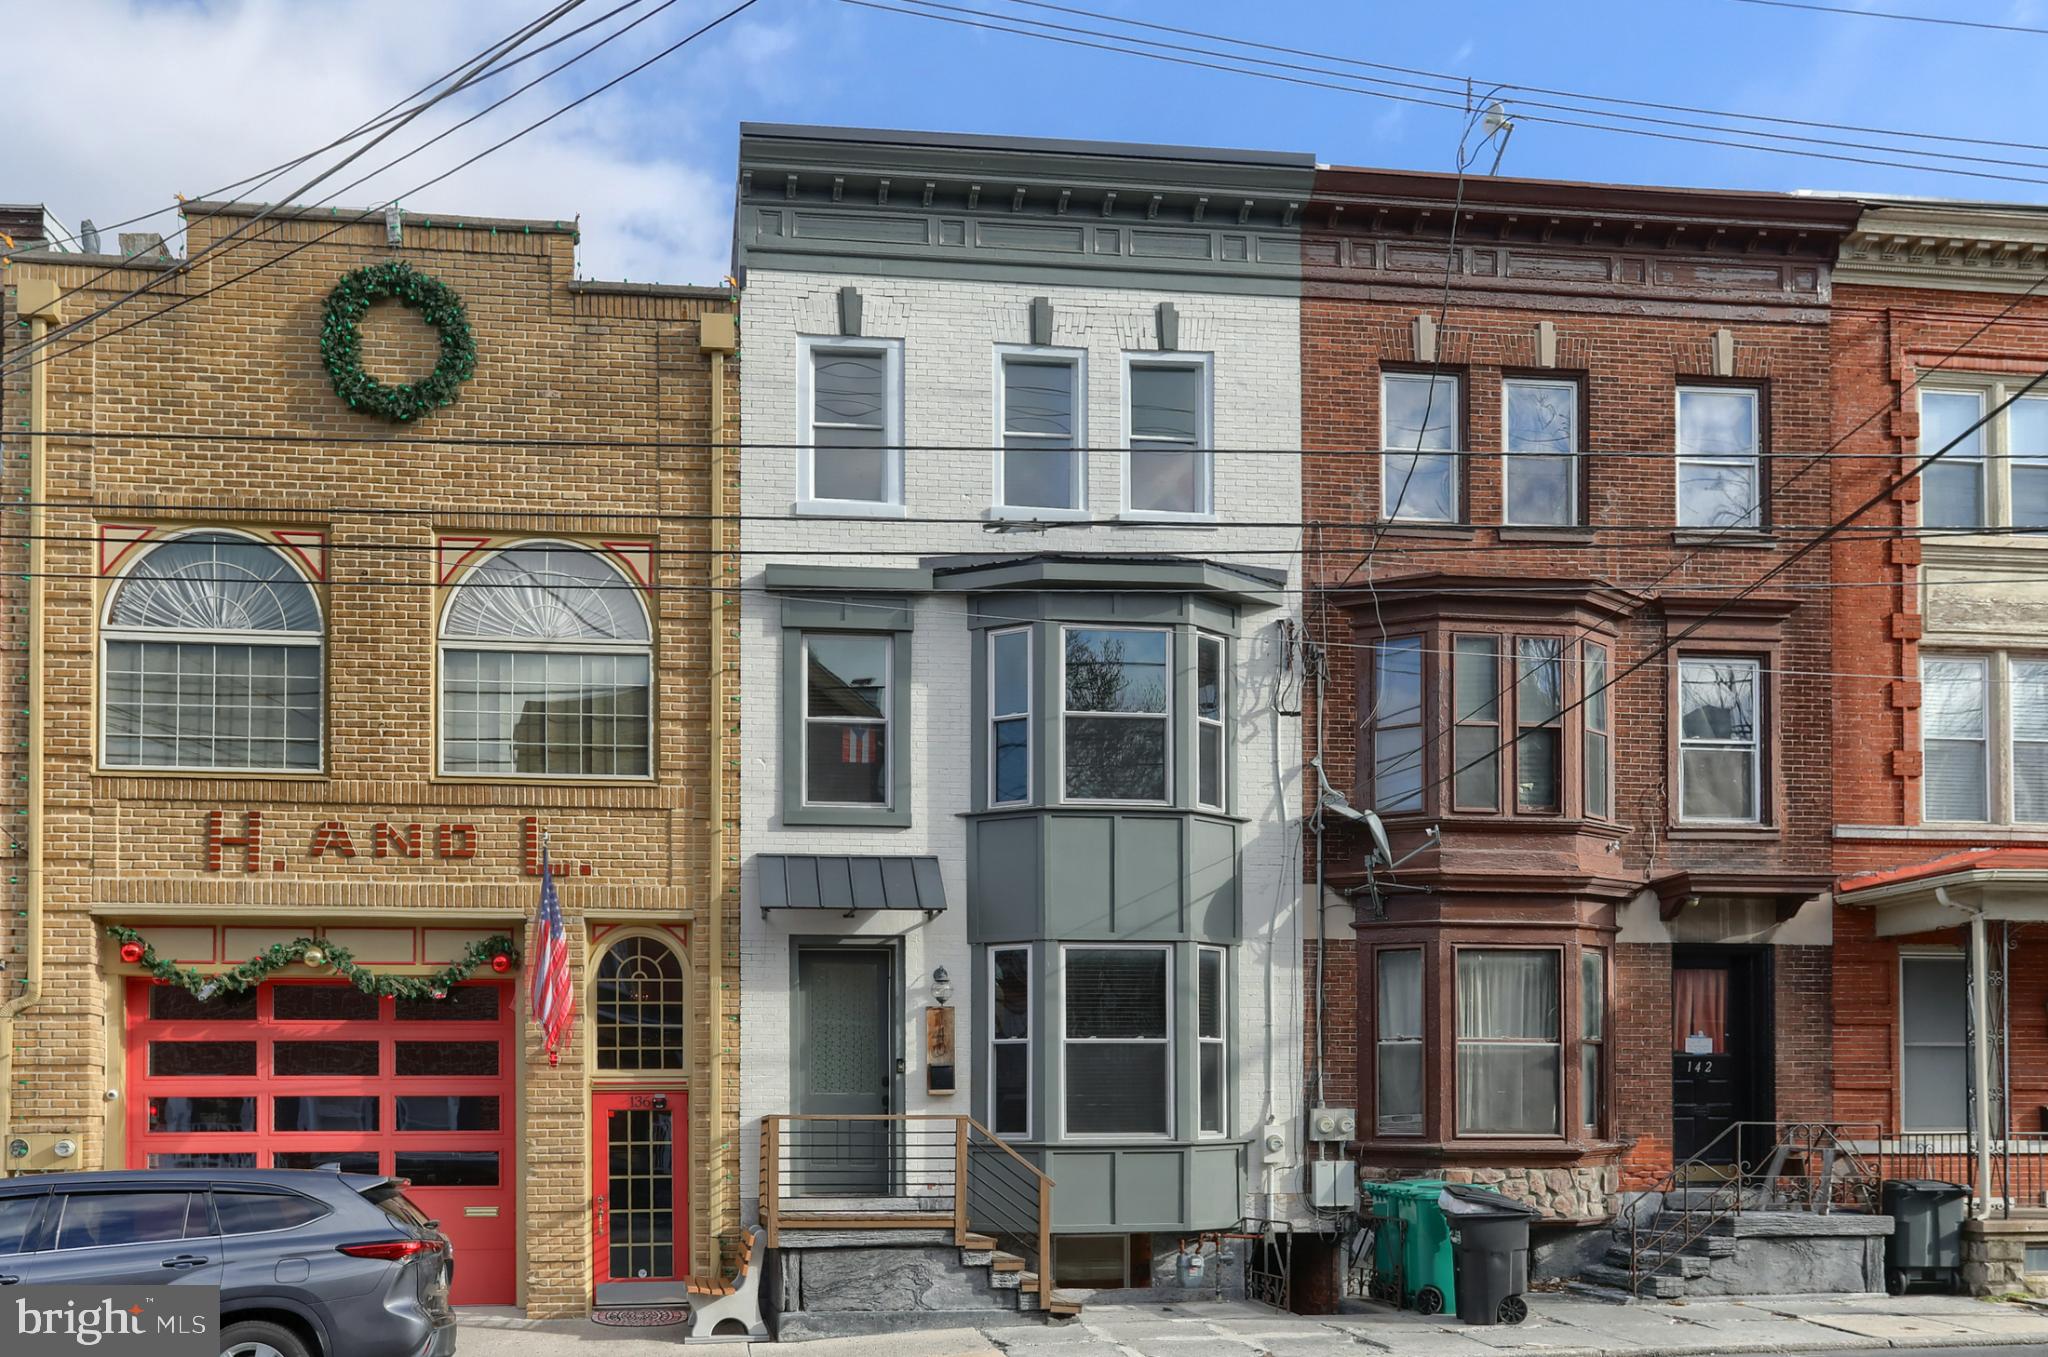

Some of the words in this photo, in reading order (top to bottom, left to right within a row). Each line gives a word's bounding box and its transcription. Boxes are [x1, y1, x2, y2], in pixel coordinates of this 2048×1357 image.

[209, 811, 285, 872] H.
[310, 822, 477, 857] AND
[525, 816, 592, 876] L.
[1687, 1060, 1713, 1073] 142
[630, 1095, 651, 1108] 136
